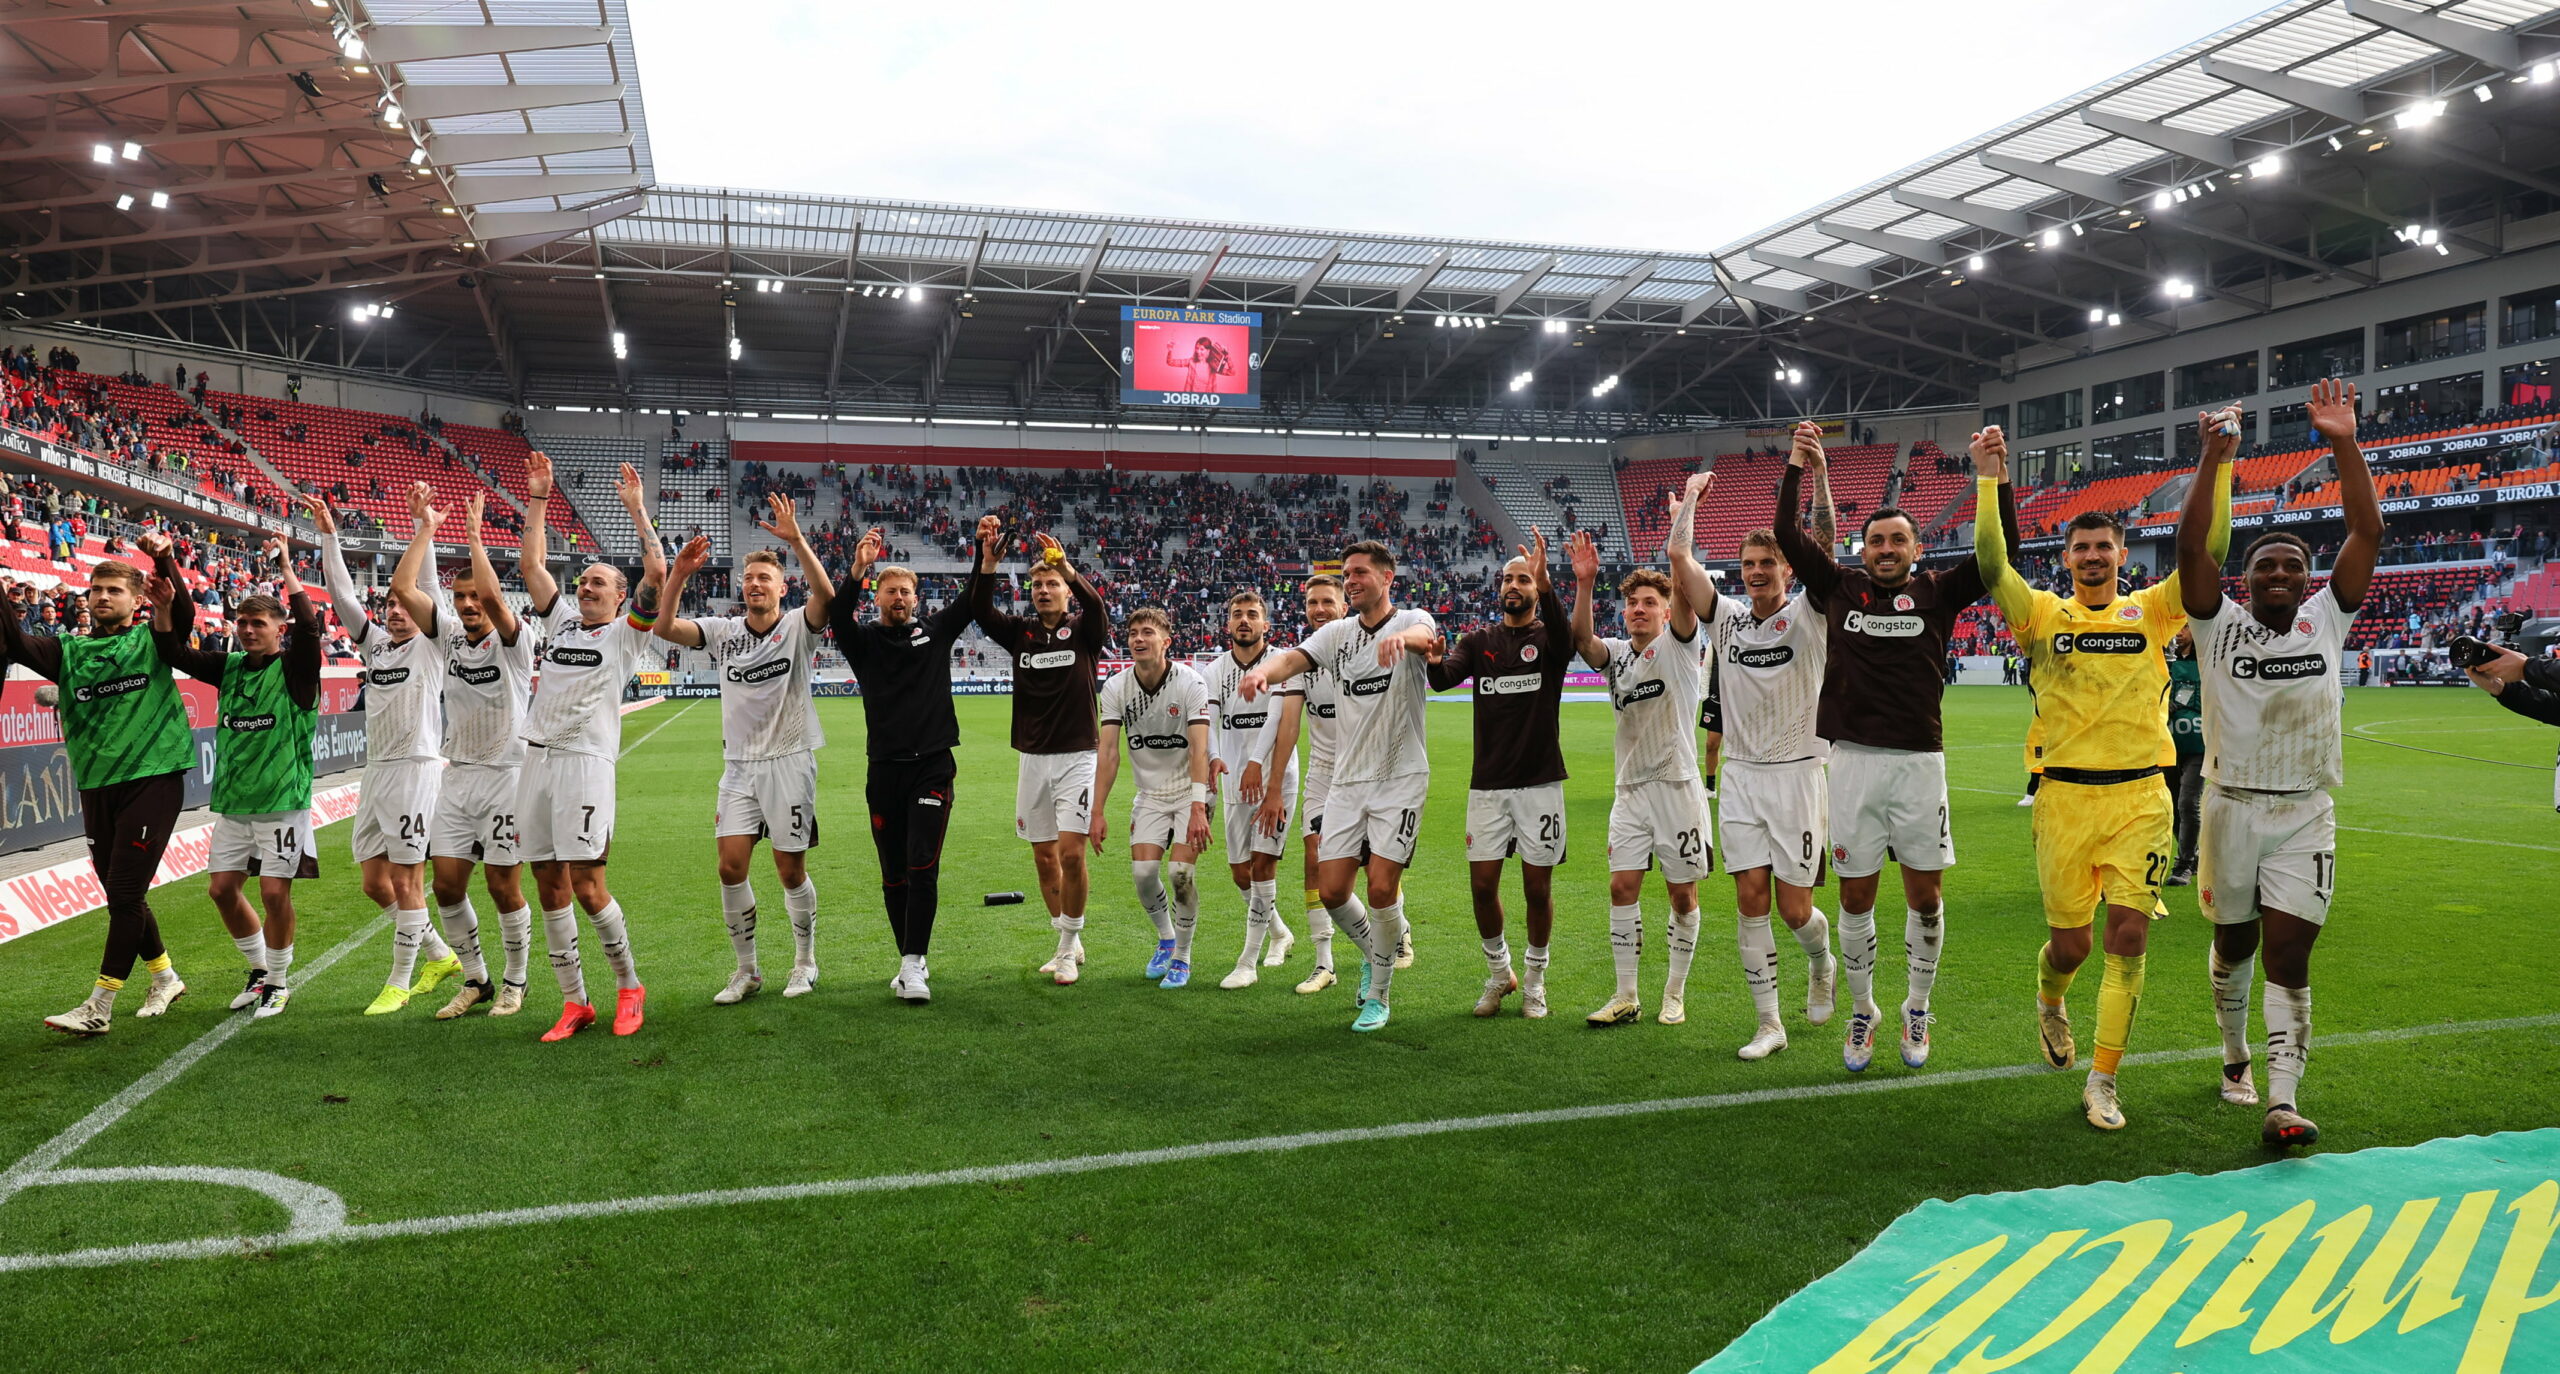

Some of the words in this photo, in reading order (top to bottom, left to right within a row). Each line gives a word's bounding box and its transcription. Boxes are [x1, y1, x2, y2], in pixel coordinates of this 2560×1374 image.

[1133, 309, 1180, 321] EUROPA
[1184, 312, 1216, 322] PARK
[1218, 313, 1251, 324] Stadion
[1162, 392, 1220, 406] JOBRAD
[2388, 445, 2431, 460] JOBRAD
[2441, 438, 2488, 452] JOBRAD
[2431, 493, 2480, 508] JOBRAD
[2496, 484, 2555, 502] EUROPA
[2378, 500, 2420, 513] OBRAD
[2231, 516, 2263, 528] OBRAD
[2272, 511, 2312, 524] JOBRAD
[2140, 526, 2174, 538] JOBRAD
[346, 538, 361, 546] VAG
[380, 542, 409, 551] Freibur
[436, 544, 456, 554] unden
[504, 550, 521, 558] Freib
[546, 554, 571, 562] bunden
[587, 554, 600, 563] VAG
[1867, 618, 1918, 632] congstar
[2081, 636, 2142, 651] congstar
[1035, 654, 1072, 666] congstar
[1742, 650, 1788, 665] congstar
[747, 662, 788, 680] congstar
[2264, 659, 2323, 675] congstar
[97, 678, 146, 694] congstar
[640, 674, 662, 684] OTTO
[1500, 676, 1541, 688] congstar
[653, 687, 673, 696] des
[676, 686, 721, 698] Europa-
[812, 683, 861, 696] ANTICA
[950, 683, 992, 692] serwelt
[994, 683, 1013, 692] des
[1632, 682, 1661, 699] gstar
[233, 717, 274, 729] congstar
[1147, 736, 1184, 748] congstar
[1078, 788, 1089, 811] 4
[581, 806, 596, 832] 7
[791, 805, 802, 830] 5
[1398, 808, 1417, 838] 19
[1938, 806, 1947, 838] 2
[142, 826, 148, 840] 1
[400, 812, 425, 840] 24
[492, 814, 515, 840] 25
[1539, 813, 1560, 842] 26
[274, 826, 296, 853] 14
[1676, 828, 1701, 860] 23
[1802, 832, 1813, 860] 8
[2145, 852, 2168, 888] 22
[2312, 852, 2334, 890] 17
[8, 860, 108, 925] Weber
